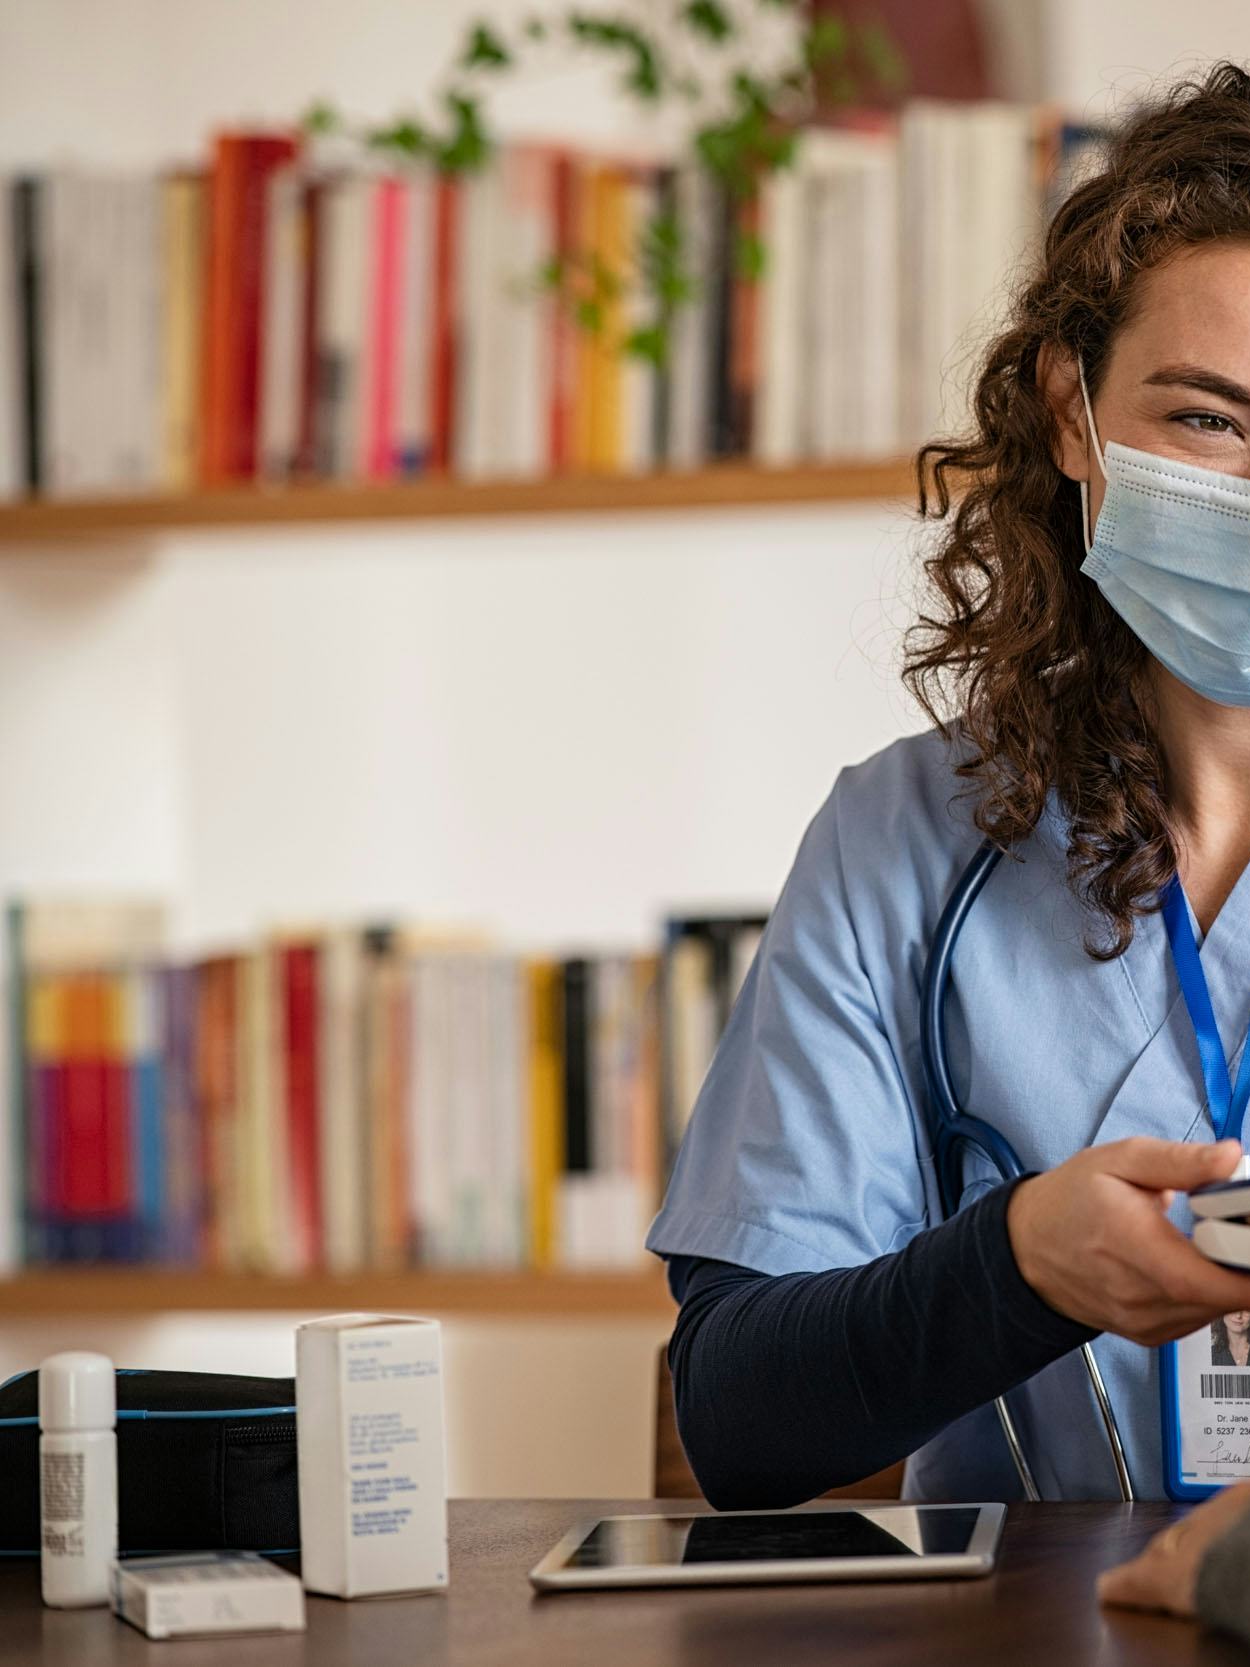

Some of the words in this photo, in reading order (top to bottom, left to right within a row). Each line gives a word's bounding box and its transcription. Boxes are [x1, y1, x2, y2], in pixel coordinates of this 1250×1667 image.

[1217, 1414, 1228, 1423] Dr.
[1230, 1415, 1248, 1423] Jane
[1204, 1427, 1212, 1435] ID
[1216, 1427, 1235, 1435] 5237
